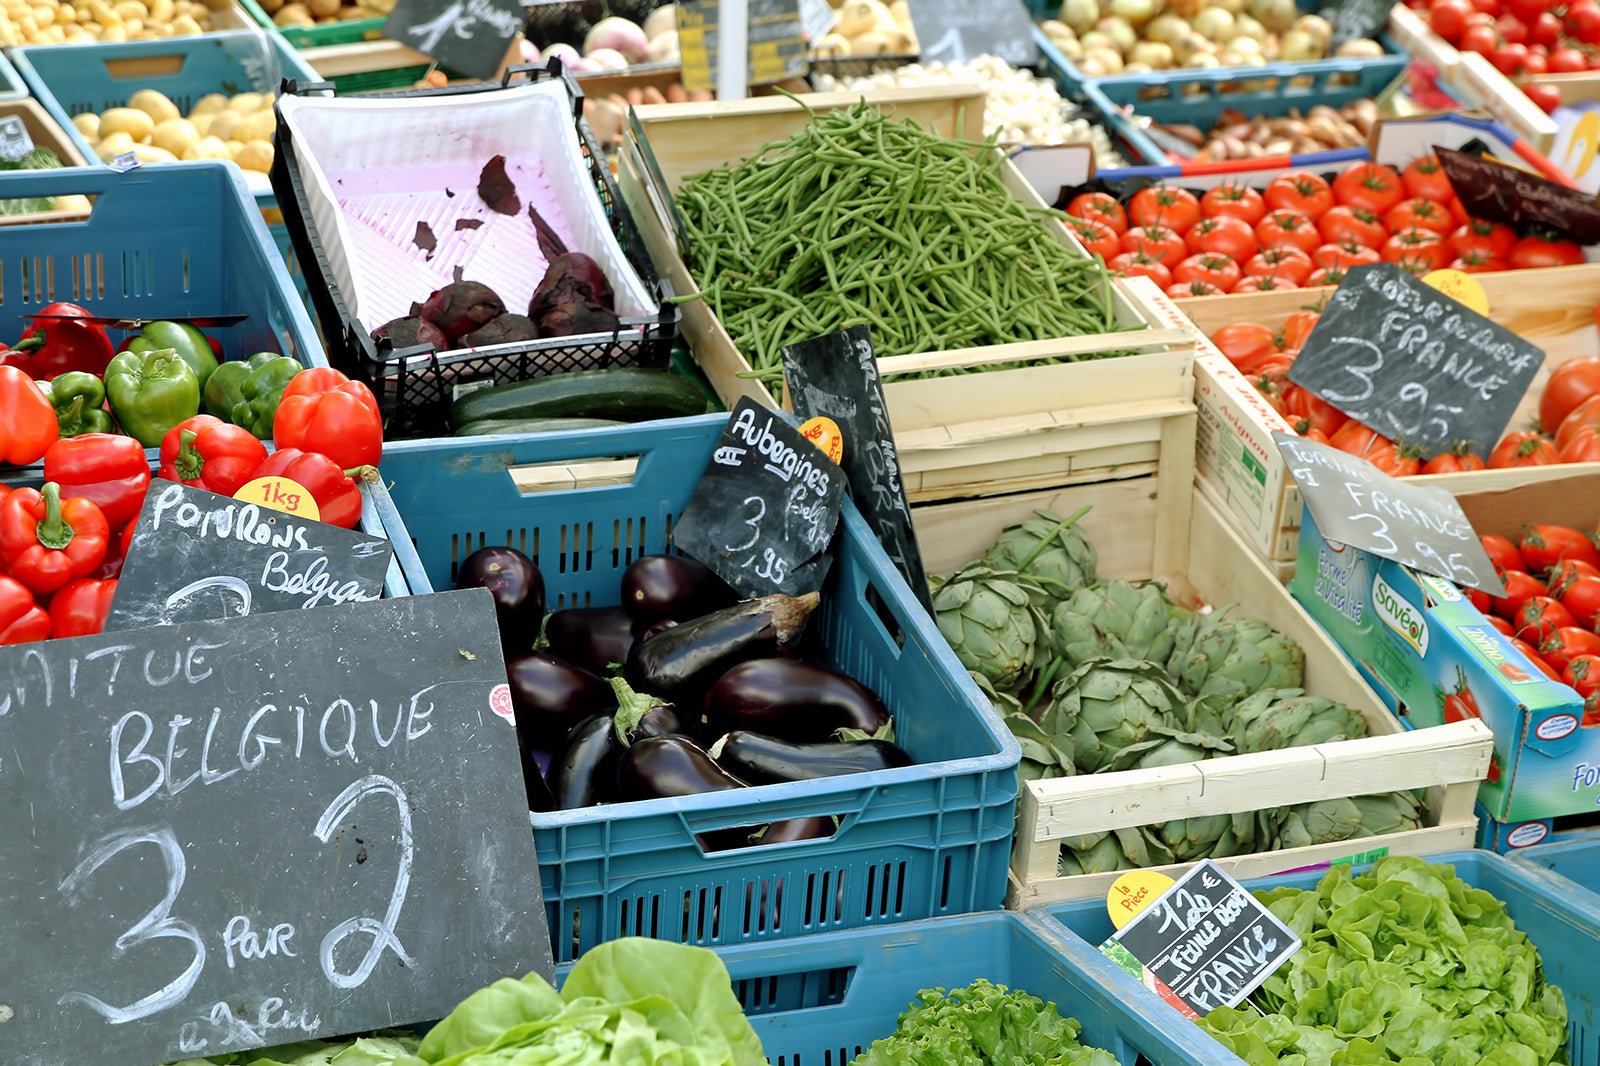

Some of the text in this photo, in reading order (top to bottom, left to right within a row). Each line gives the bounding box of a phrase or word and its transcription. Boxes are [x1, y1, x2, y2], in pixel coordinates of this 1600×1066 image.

[1380, 311, 1509, 401] FRANCE
[732, 408, 830, 497] Aubergines
[1220, 404, 1269, 461] Avignon
[261, 482, 301, 511] 1kg
[1345, 482, 1471, 541] FRANCE
[1318, 548, 1347, 587] Forme
[1324, 580, 1363, 625] Vitalité
[1375, 582, 1425, 647] Savéol
[0, 642, 230, 716] AITUE
[109, 688, 435, 810] BELGIQUE
[58, 824, 206, 1026] 3
[314, 774, 418, 990] 2
[1114, 884, 1131, 896] la
[1121, 885, 1149, 912] Pièce
[1202, 871, 1222, 889] €
[1189, 924, 1277, 1013] FRANCE
